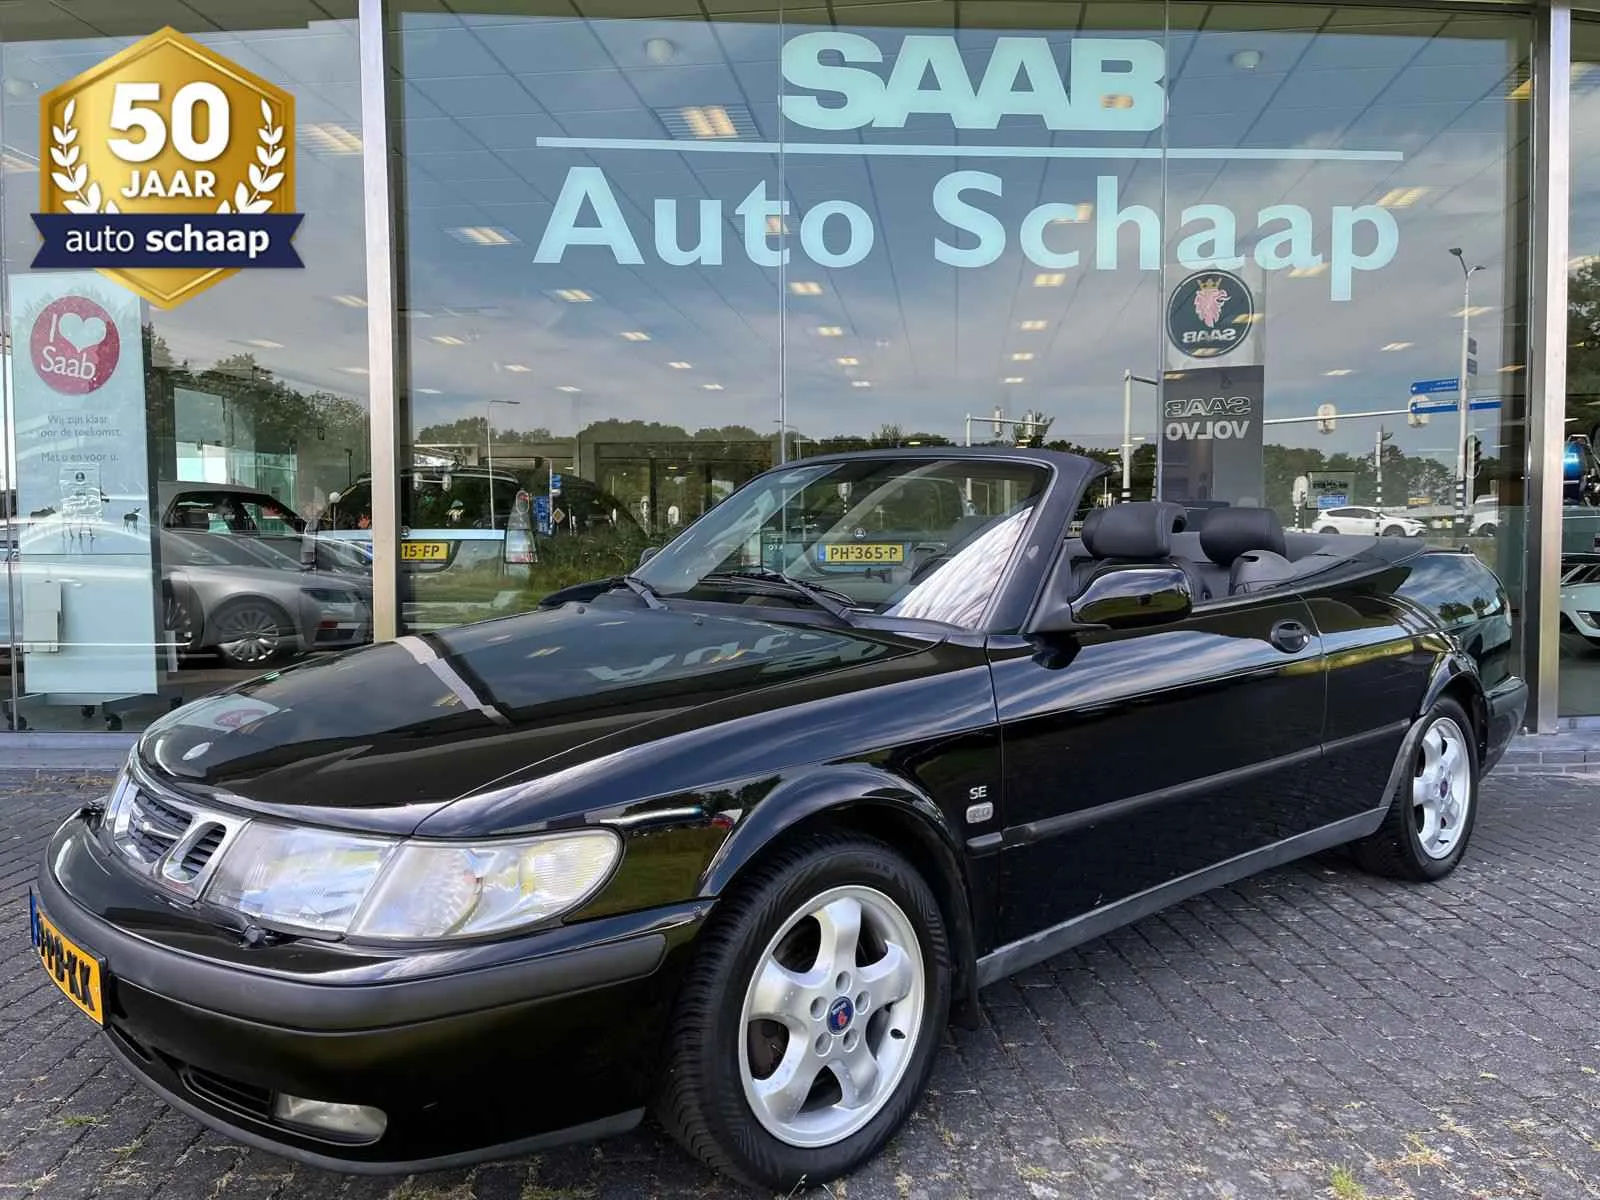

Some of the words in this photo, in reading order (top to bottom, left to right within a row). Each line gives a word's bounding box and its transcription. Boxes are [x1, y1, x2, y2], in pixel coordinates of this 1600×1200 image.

[777, 32, 1169, 130] SAAB
[532, 166, 875, 268] Auto
[932, 170, 1400, 301] Schaap
[49, 313, 58, 343] I
[830, 546, 898, 561] PH-365-P
[969, 785, 987, 800] SE
